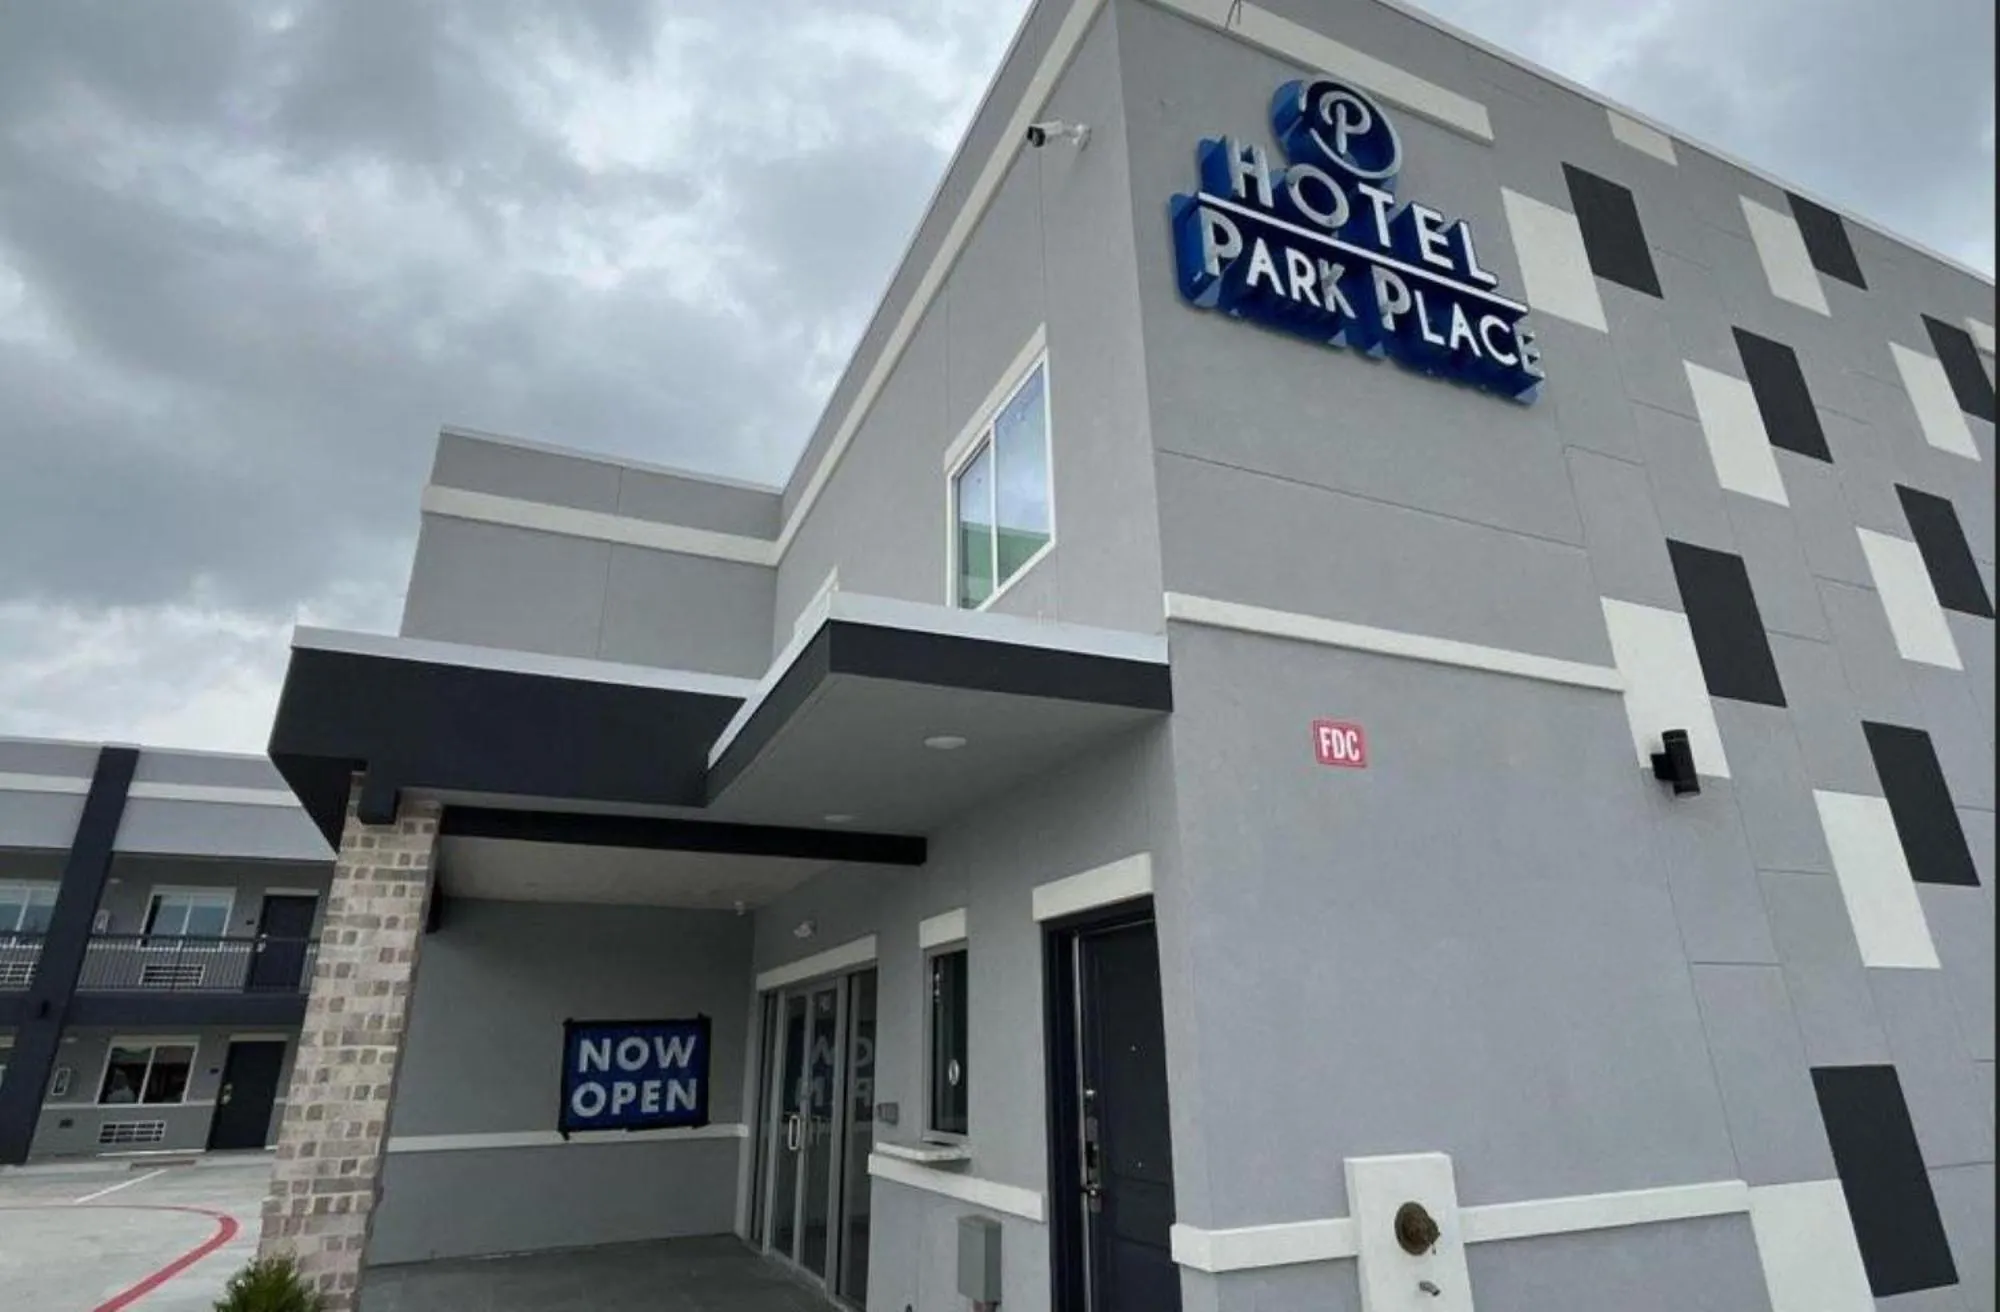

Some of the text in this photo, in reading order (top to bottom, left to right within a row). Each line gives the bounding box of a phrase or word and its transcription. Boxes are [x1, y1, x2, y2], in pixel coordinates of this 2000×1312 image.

[1318, 90, 1372, 154] P
[1231, 138, 1497, 287] HOTEL
[1200, 207, 1545, 378] PARK PLACE
[1319, 726, 1360, 761] FDC
[578, 1036, 697, 1073] NOW
[571, 1078, 698, 1118] OPEN
